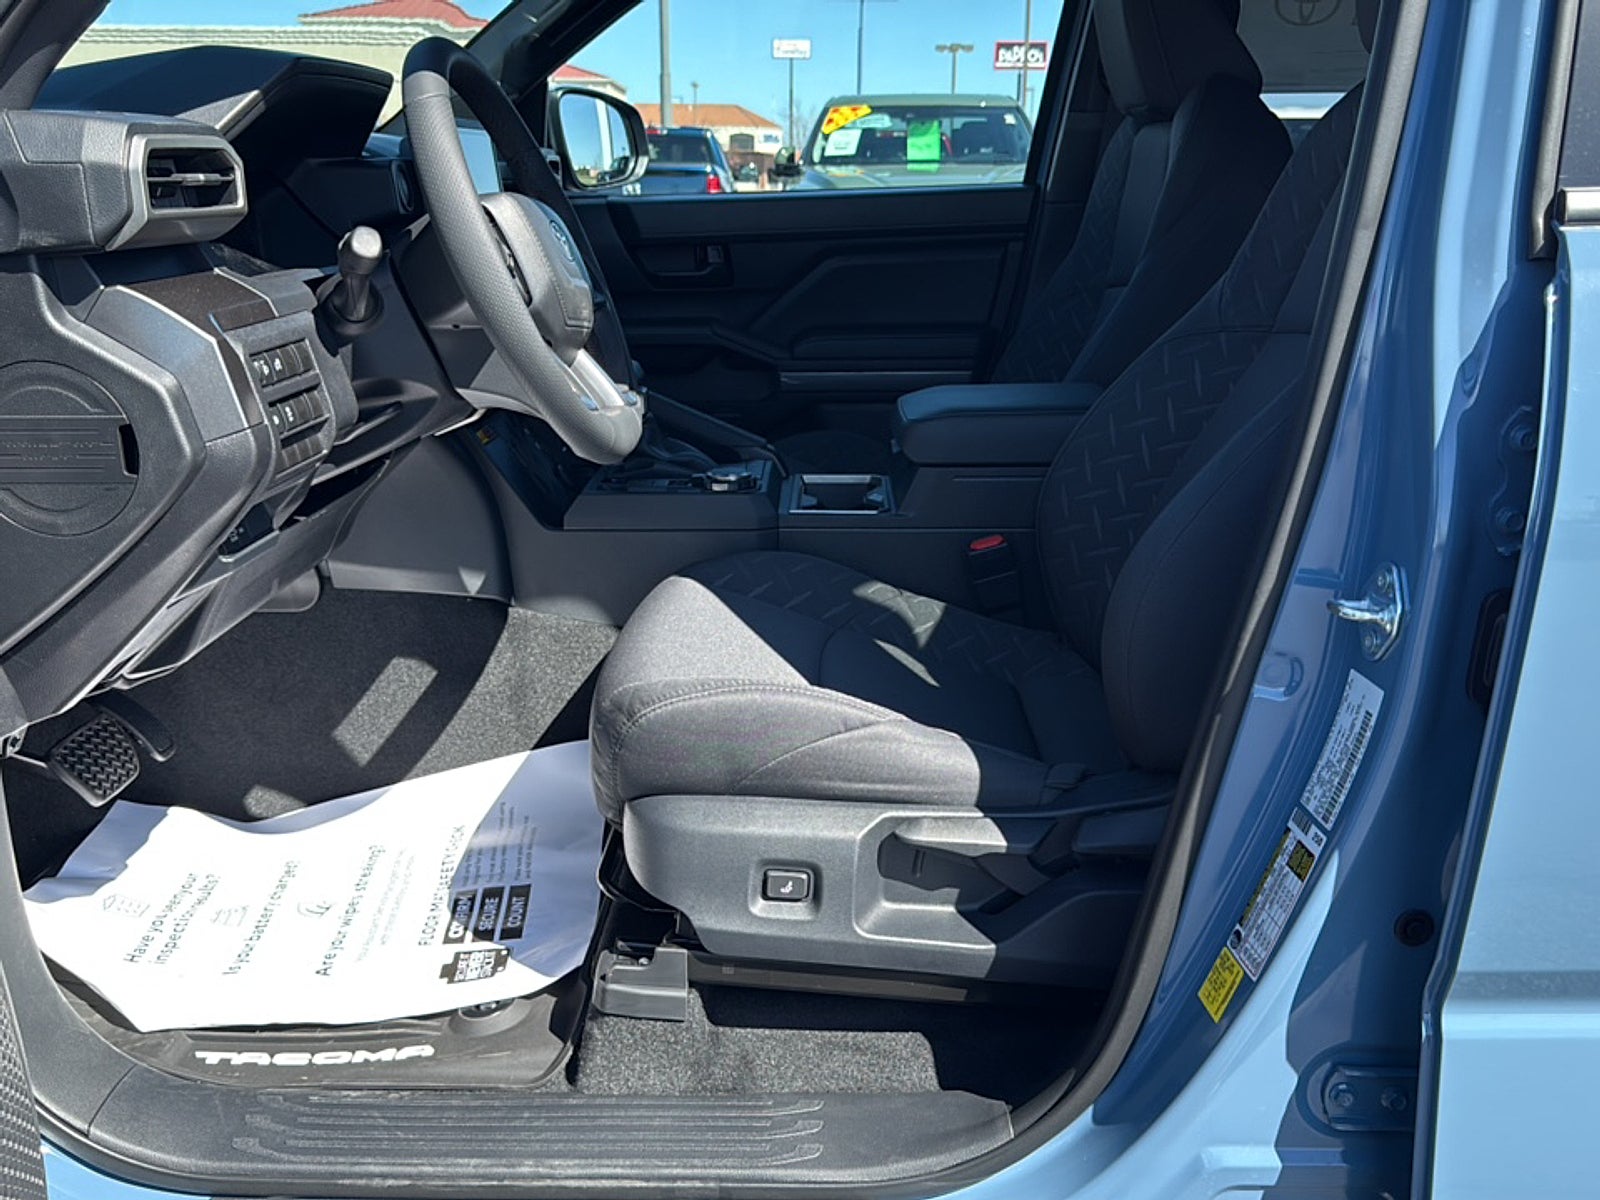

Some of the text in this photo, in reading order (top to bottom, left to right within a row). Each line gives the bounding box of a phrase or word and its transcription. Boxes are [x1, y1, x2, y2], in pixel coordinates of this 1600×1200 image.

[123, 935, 154, 963] Have
[181, 873, 197, 896] your
[478, 897, 499, 931] SECURE
[507, 896, 526, 928] COUNT
[315, 953, 336, 977] Are
[330, 930, 347, 953] your
[222, 965, 242, 976] Is
[195, 1045, 435, 1066] TACOMA
